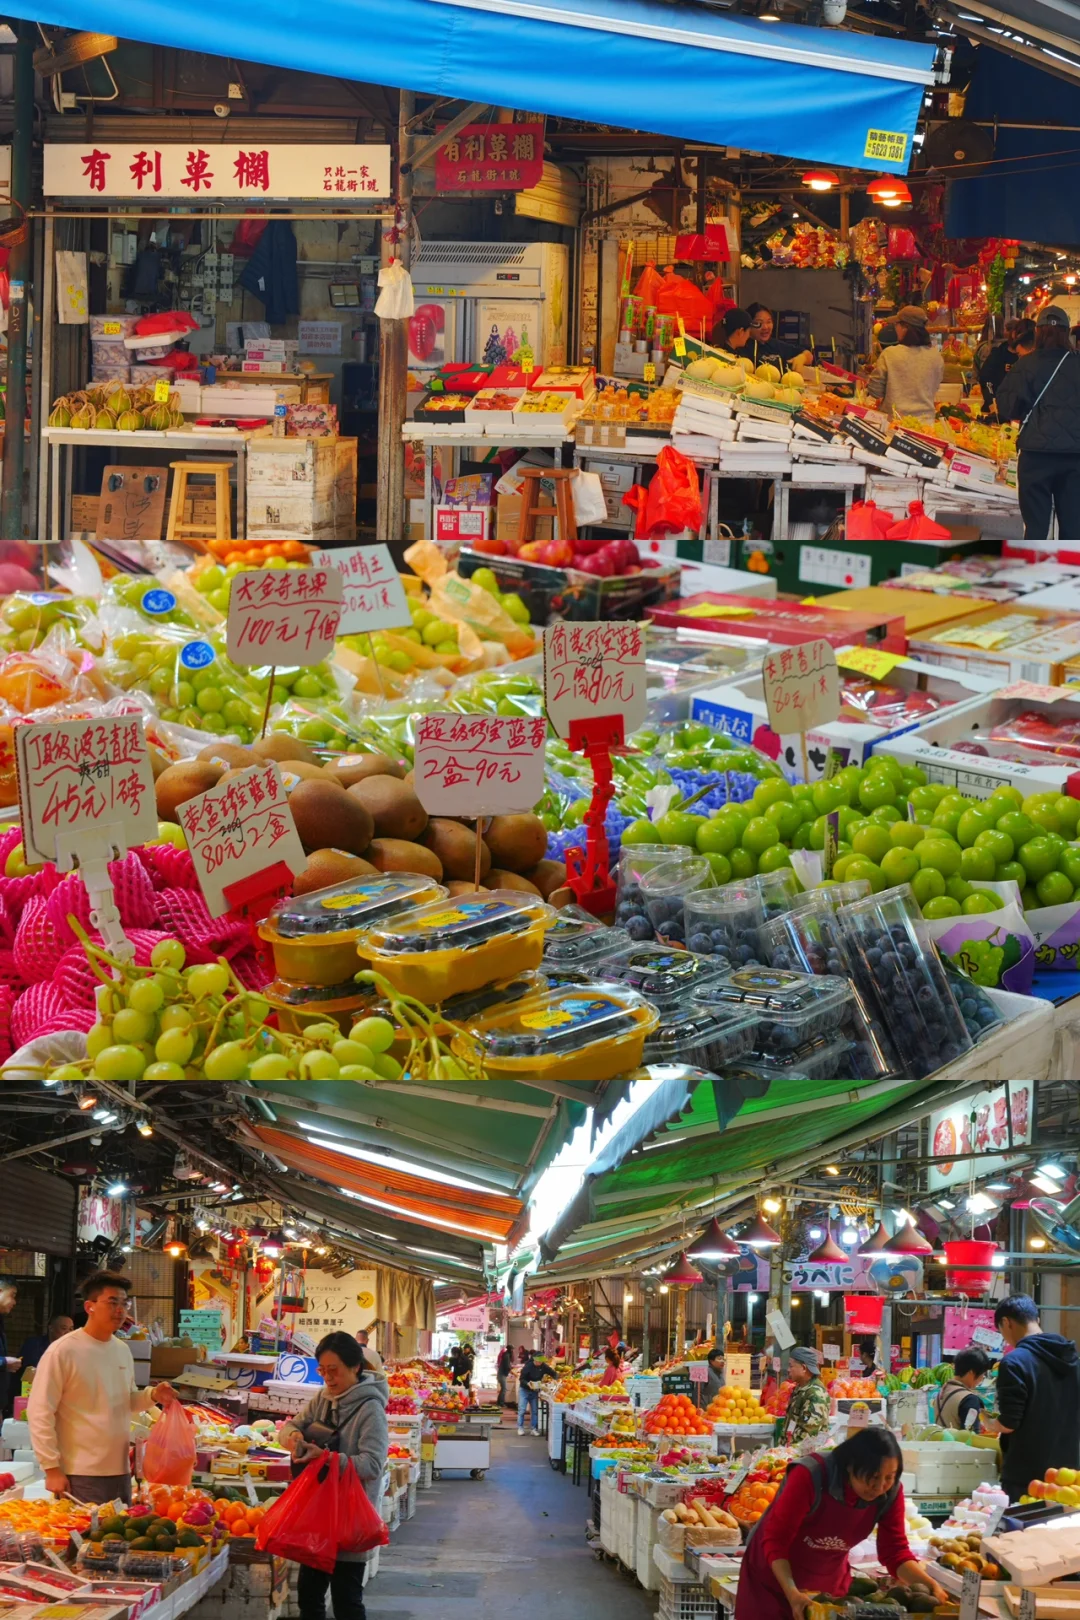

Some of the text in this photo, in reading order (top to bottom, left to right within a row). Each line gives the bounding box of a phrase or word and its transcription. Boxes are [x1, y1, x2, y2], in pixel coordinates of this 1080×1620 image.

[444, 133, 535, 162] 有利菓欄
[871, 143, 888, 157] 5623
[888, 145, 903, 159] 1381
[80, 148, 270, 192] 有利菓欄
[324, 165, 370, 179] 只此一家
[457, 169, 520, 182] 石龍街1號
[323, 179, 379, 192] 石龍街1號
[322, 1318, 345, 1327] 車厘子
